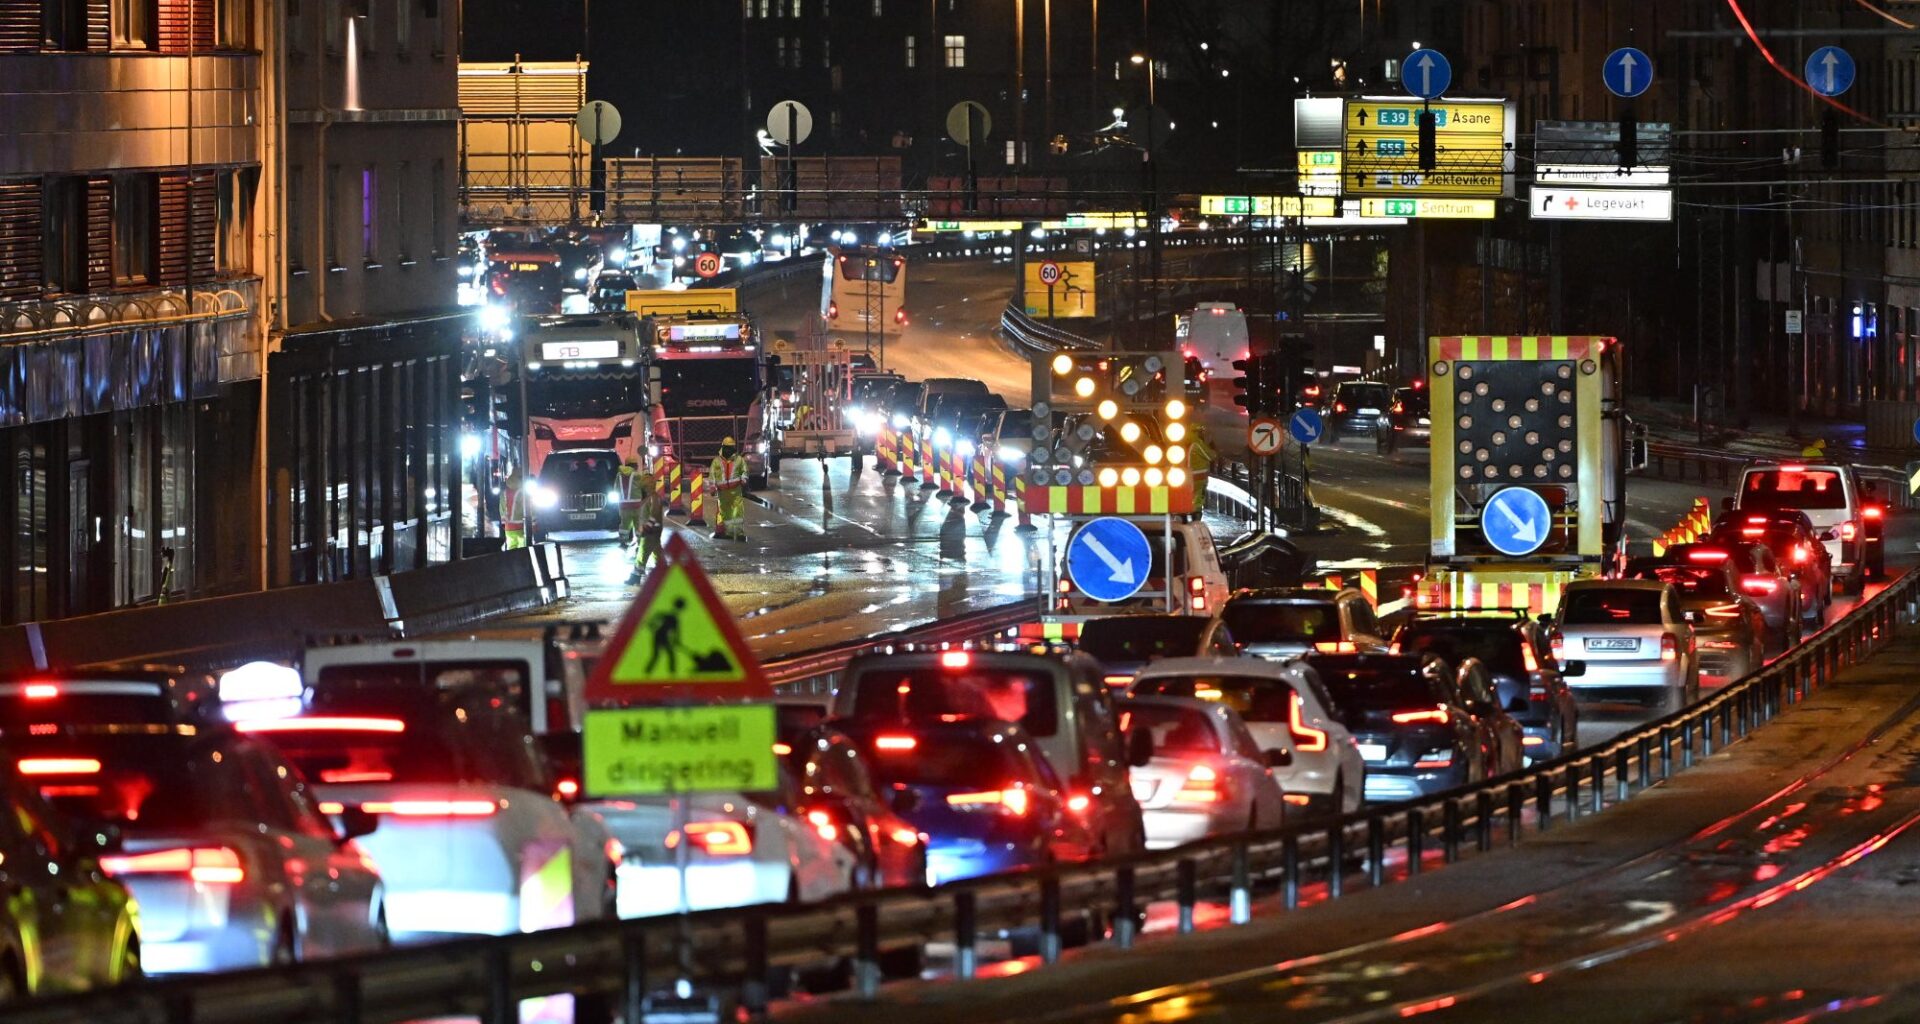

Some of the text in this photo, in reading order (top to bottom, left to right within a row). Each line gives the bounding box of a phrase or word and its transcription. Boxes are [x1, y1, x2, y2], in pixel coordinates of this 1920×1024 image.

[1380, 112, 1388, 123] E
[1391, 112, 1406, 123] 39
[1452, 109, 1491, 124] Åsane
[1401, 174, 1495, 185] DK Jekteviken
[1387, 202, 1474, 214] E 39 Sentrum
[1587, 197, 1645, 211] Legevakt
[700, 259, 716, 271] 60
[1043, 267, 1057, 279] 60
[685, 398, 728, 407] SCANIA
[621, 717, 740, 743] Manuell
[607, 757, 755, 787] dirigering
